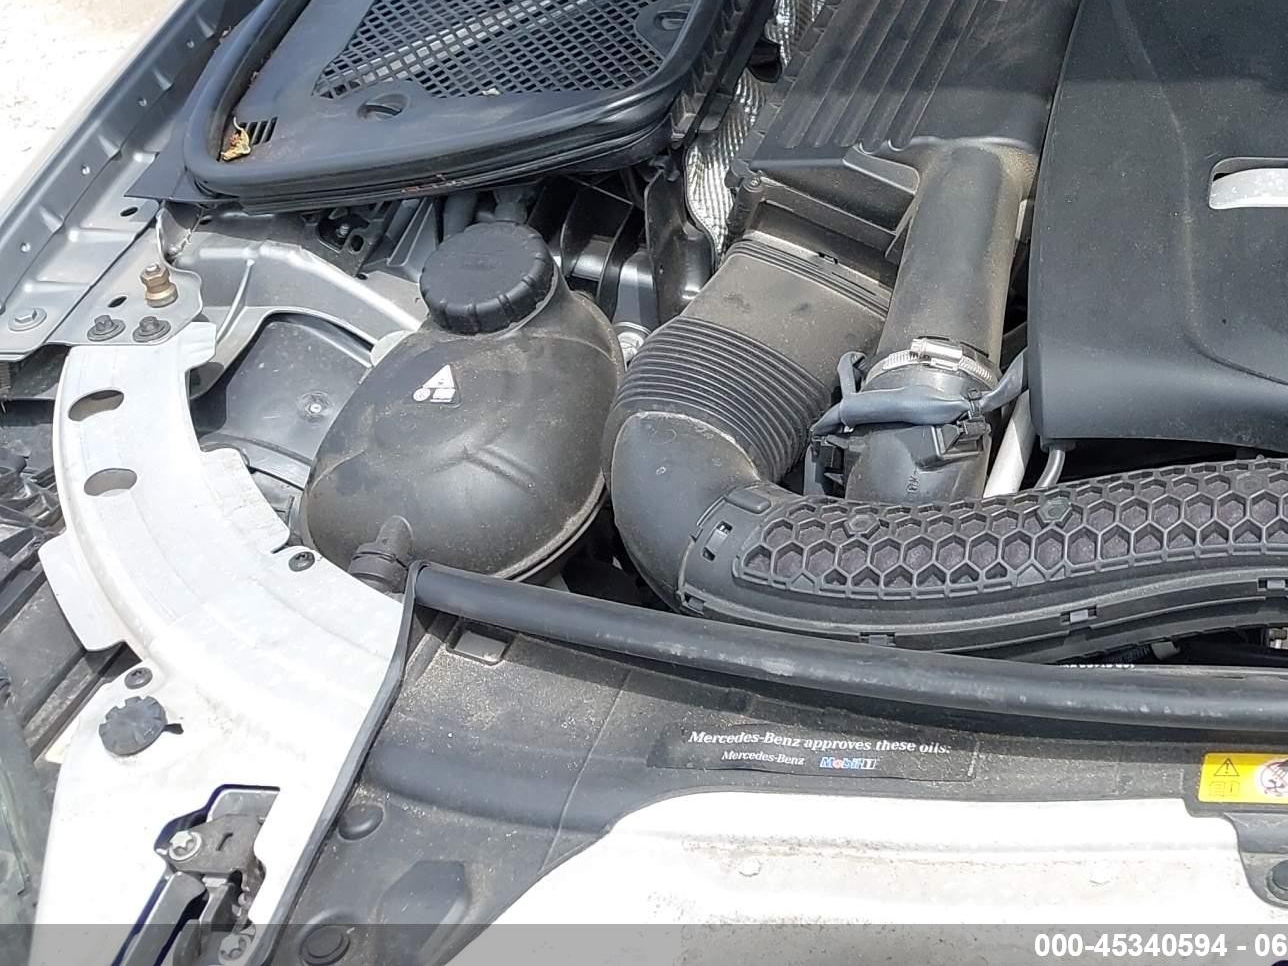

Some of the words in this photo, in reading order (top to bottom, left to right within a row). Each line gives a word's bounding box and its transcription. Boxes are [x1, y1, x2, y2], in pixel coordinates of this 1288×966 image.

[688, 731, 799, 747] Mercedes-Benz
[803, 738, 872, 751] approves
[875, 740, 917, 752] these
[721, 751, 804, 765] Mercedes-Benz
